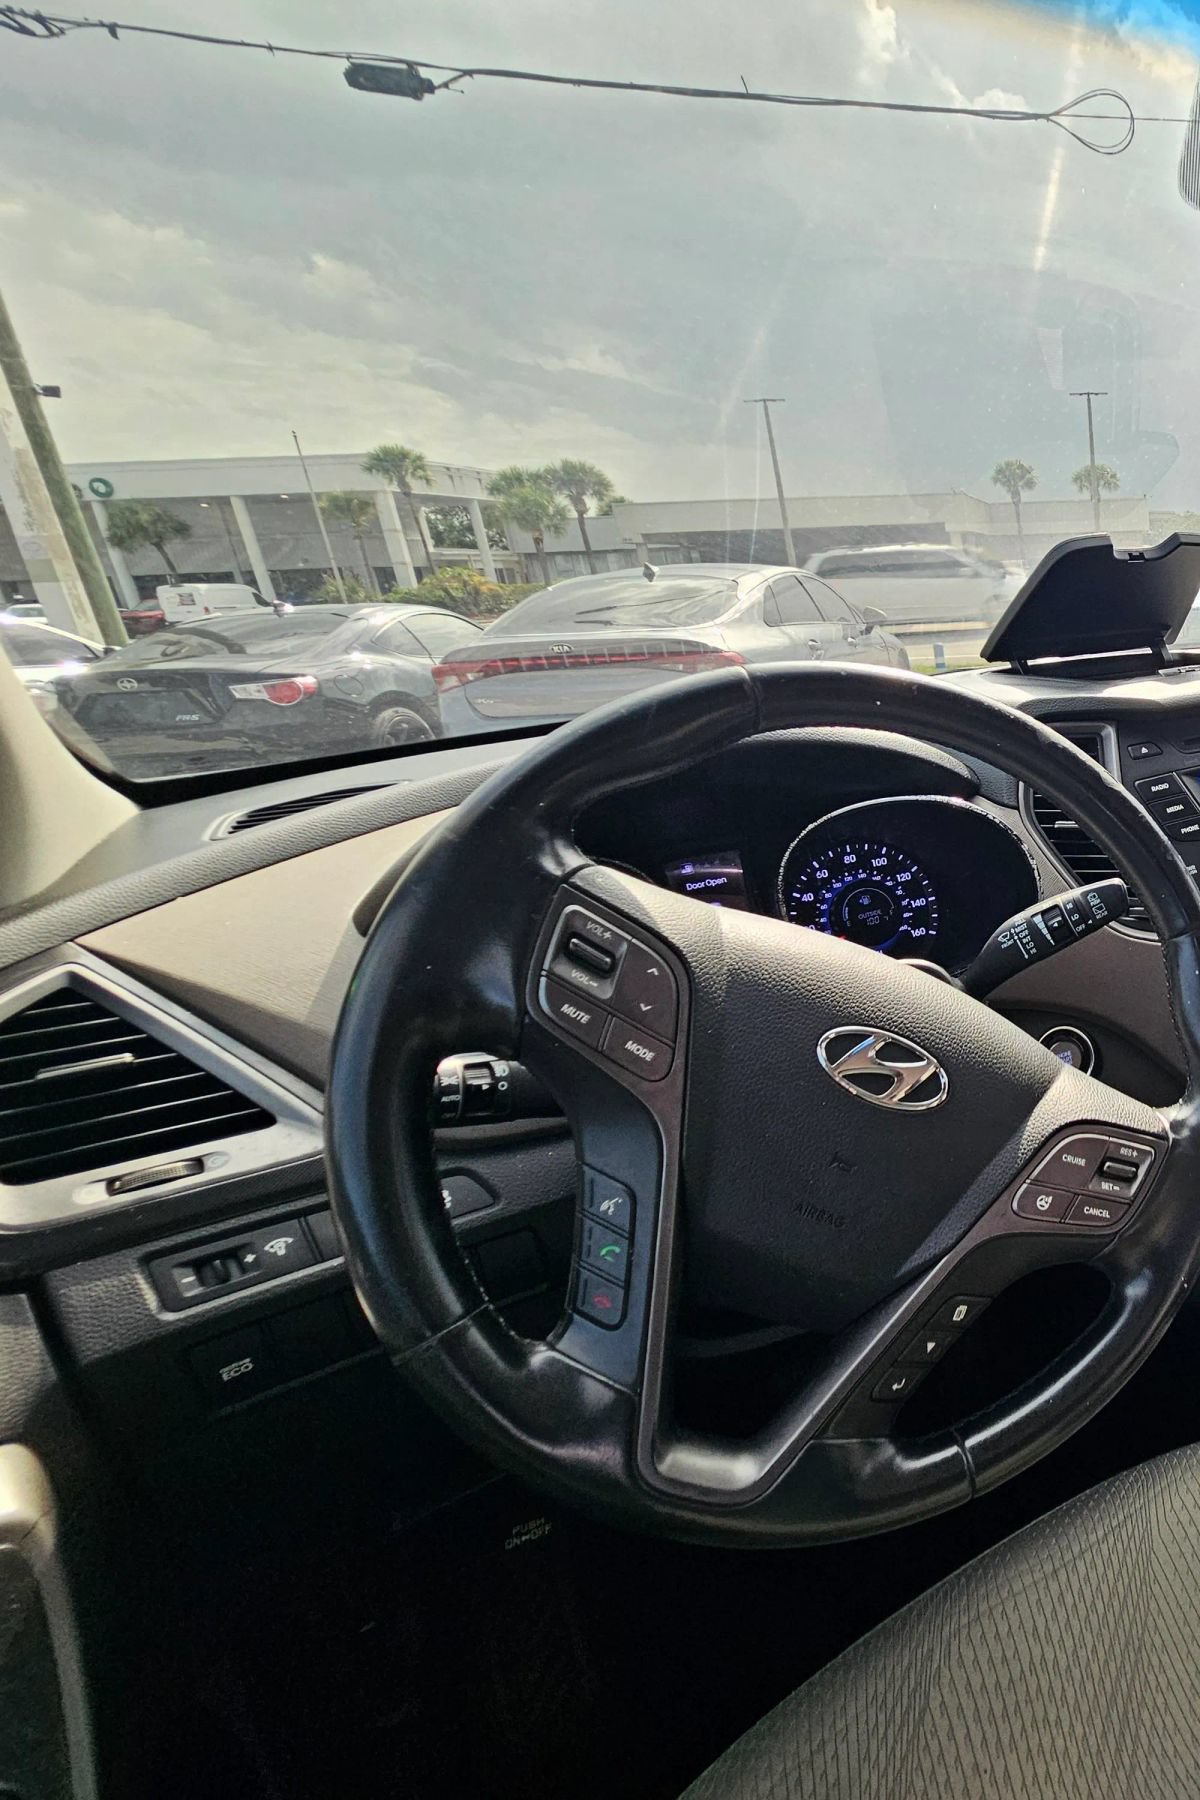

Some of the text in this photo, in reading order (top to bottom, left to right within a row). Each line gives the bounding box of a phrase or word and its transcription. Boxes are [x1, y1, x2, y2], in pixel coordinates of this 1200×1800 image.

[551, 645, 571, 654] KIA
[1150, 782, 1170, 792] RADIO
[1166, 803, 1185, 814] MEDIA
[1180, 823, 1200, 834] PHONE
[843, 854, 857, 864] 80
[871, 857, 888, 867] 100
[816, 869, 829, 879] 60
[896, 872, 912, 882] 120
[685, 877, 728, 891] Door Open
[801, 892, 814, 902] 40
[911, 897, 926, 908] 140
[1070, 913, 1080, 921] LO
[910, 927, 926, 938] 160
[1075, 923, 1086, 932] OFF
[1018, 929, 1029, 938] OFF
[1025, 941, 1035, 949] LO
[560, 1003, 592, 1025] MUTE
[624, 1040, 656, 1062] MODE
[440, 1094, 462, 1102] AUTO
[1062, 1152, 1087, 1168] CRUISE
[792, 1201, 849, 1230] AIRBAG
[1083, 1205, 1111, 1219] CANCEL
[222, 1362, 255, 1382] ECO
[511, 1517, 545, 1536] PUSH
